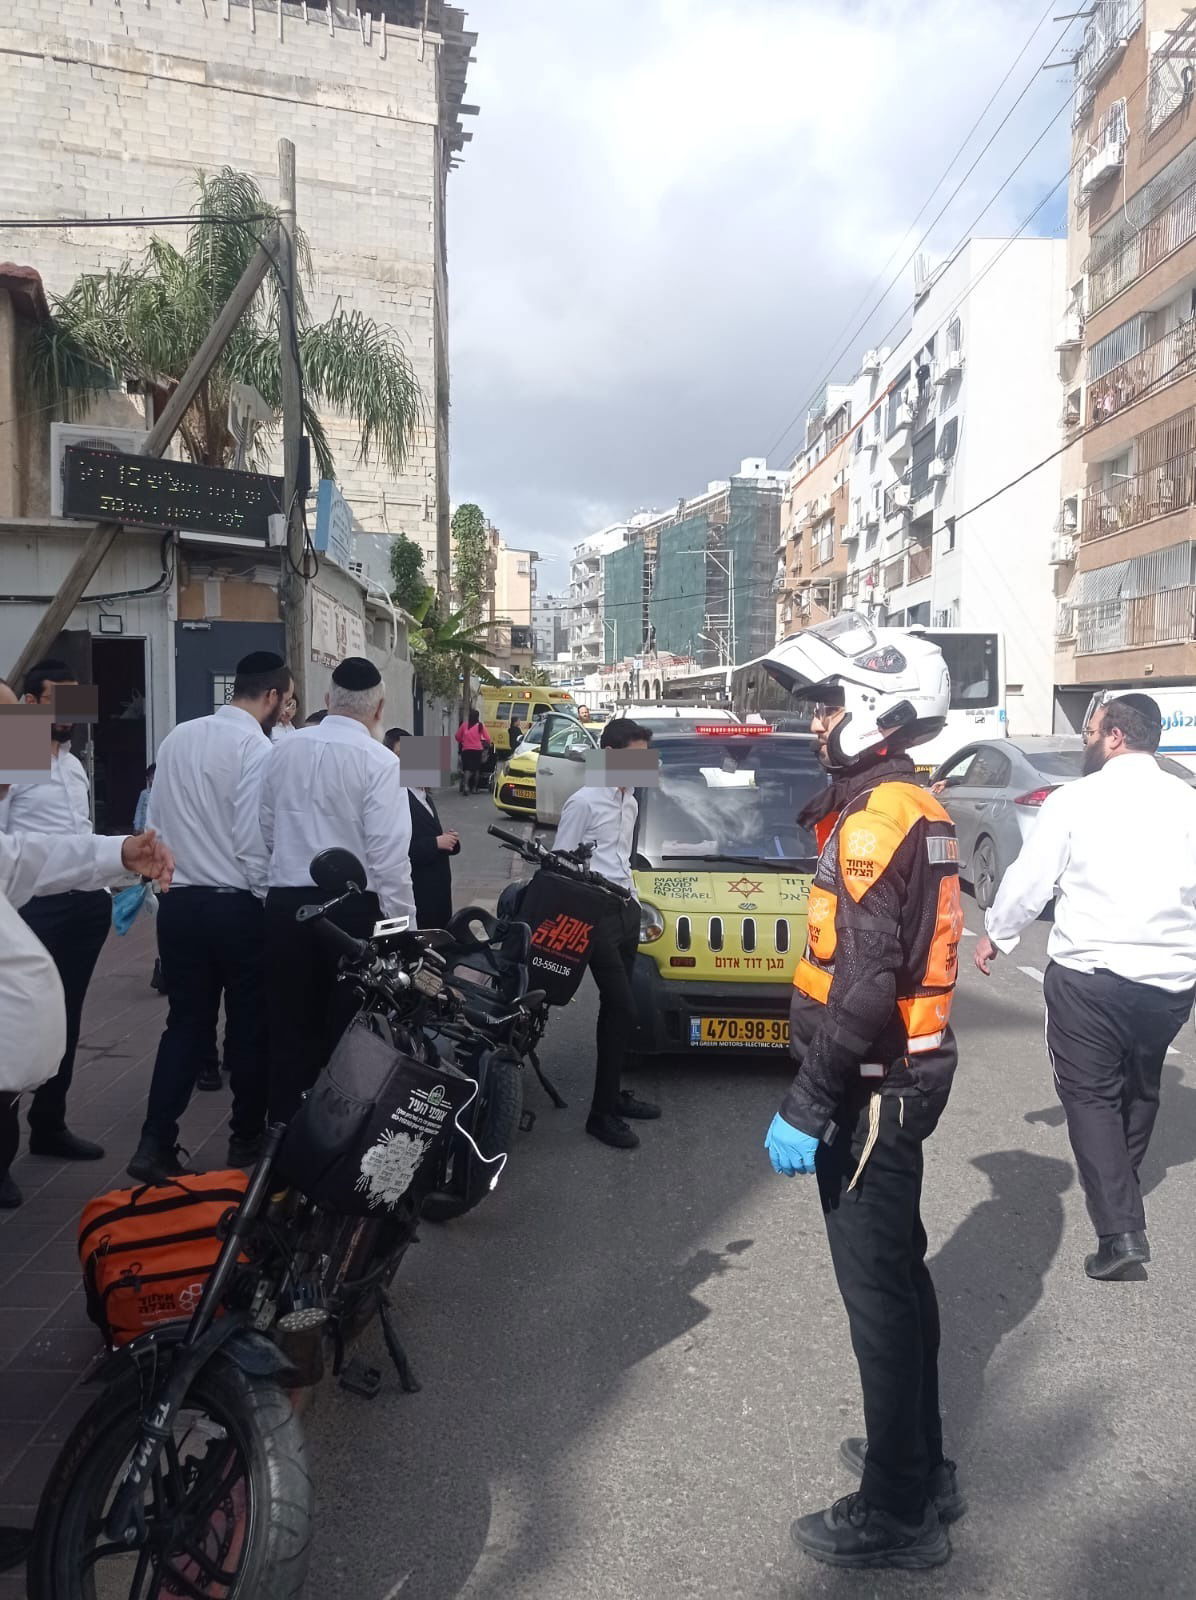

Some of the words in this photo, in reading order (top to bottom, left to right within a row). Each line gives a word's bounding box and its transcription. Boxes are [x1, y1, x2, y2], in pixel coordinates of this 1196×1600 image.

[846, 859, 874, 869] איחוד
[846, 867, 874, 878] הצלה
[532, 956, 571, 976] 03-5561136
[715, 956, 740, 969] אדום
[744, 957, 762, 969] דוד
[766, 957, 784, 971] מגן
[707, 1020, 791, 1041] 470-98-90
